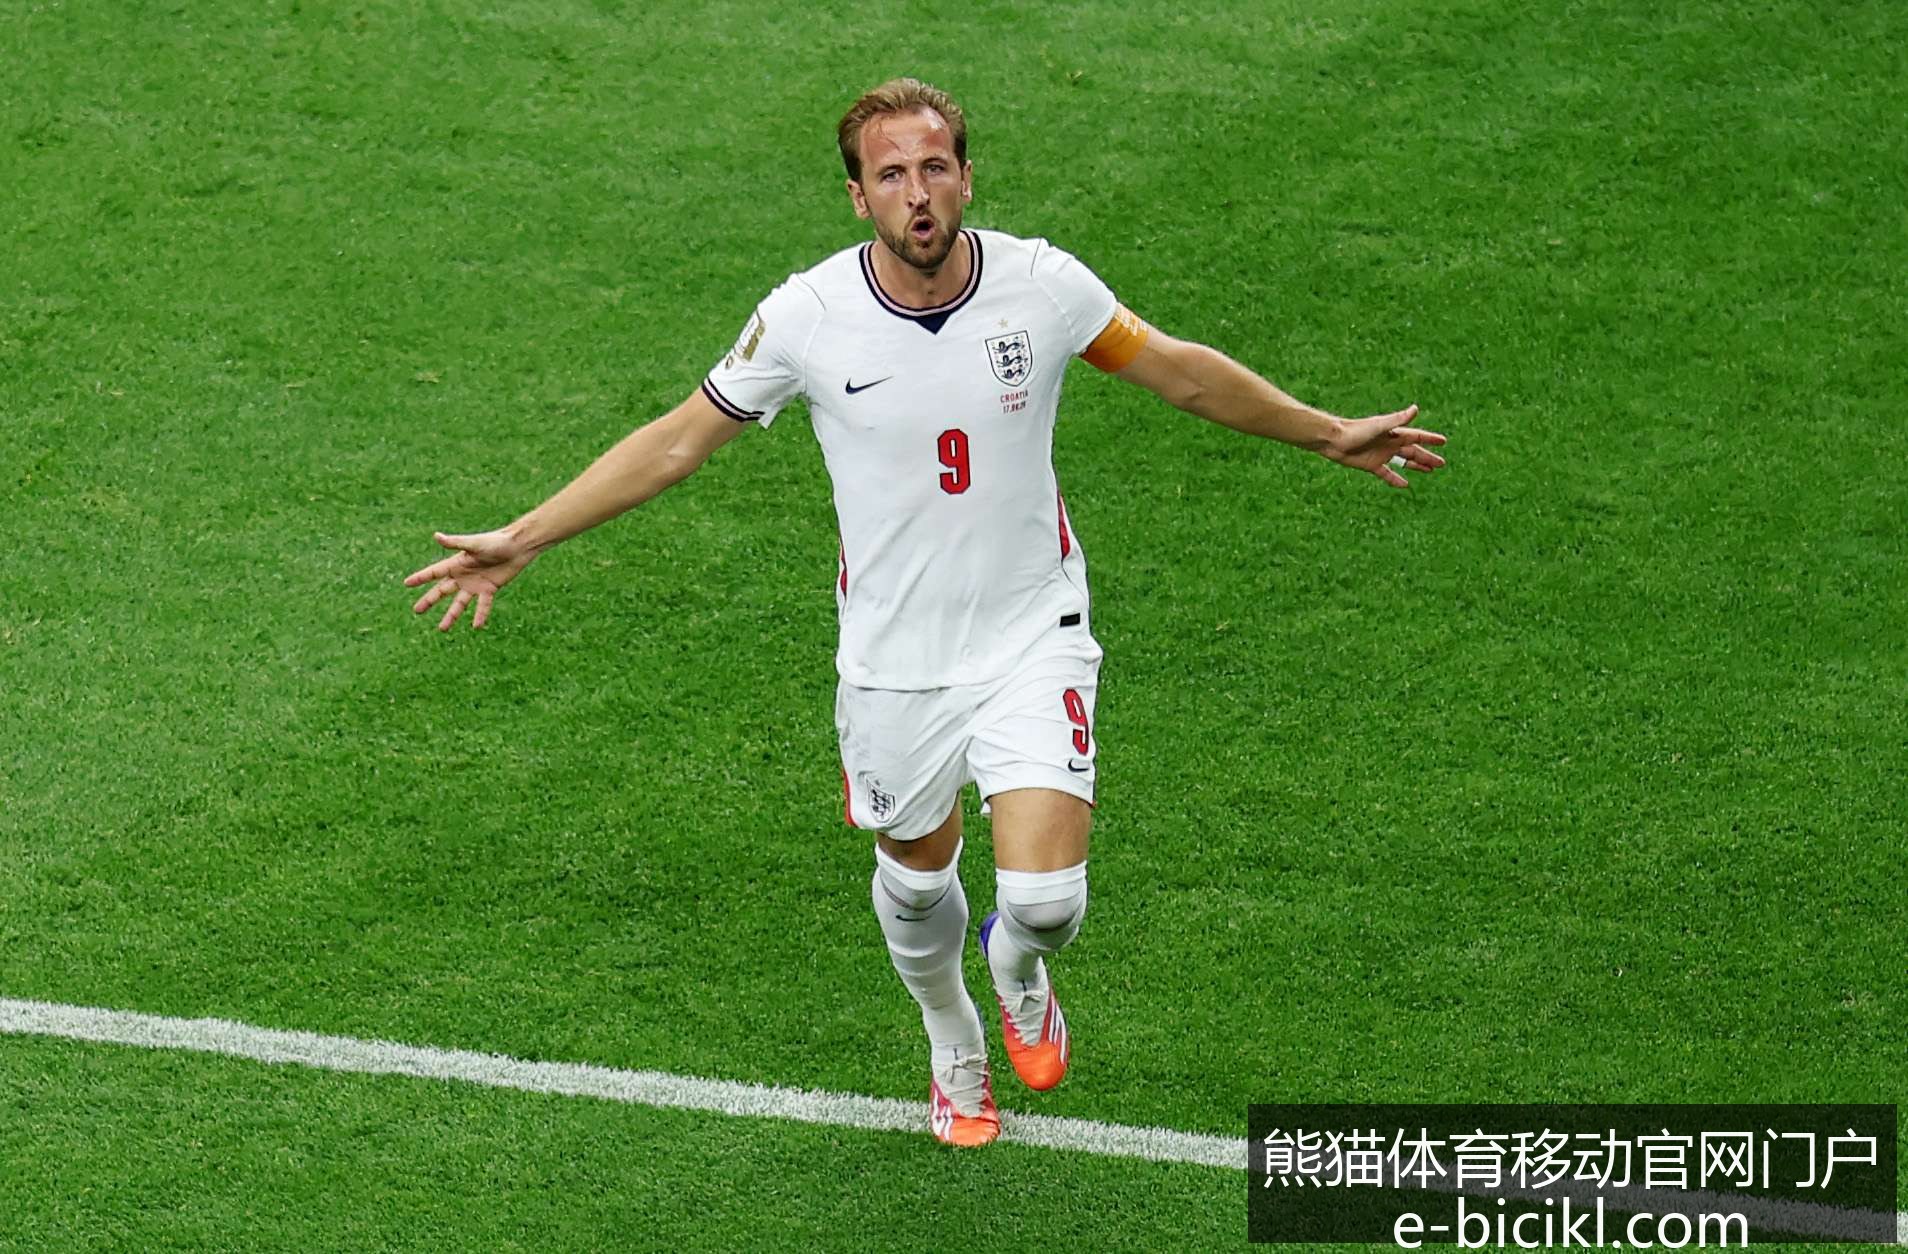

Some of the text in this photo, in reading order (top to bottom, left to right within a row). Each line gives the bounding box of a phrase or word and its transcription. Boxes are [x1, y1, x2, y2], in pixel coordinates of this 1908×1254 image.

[1000, 389, 1029, 403] CROATIA
[937, 428, 971, 495] 9
[1063, 688, 1089, 756] 9
